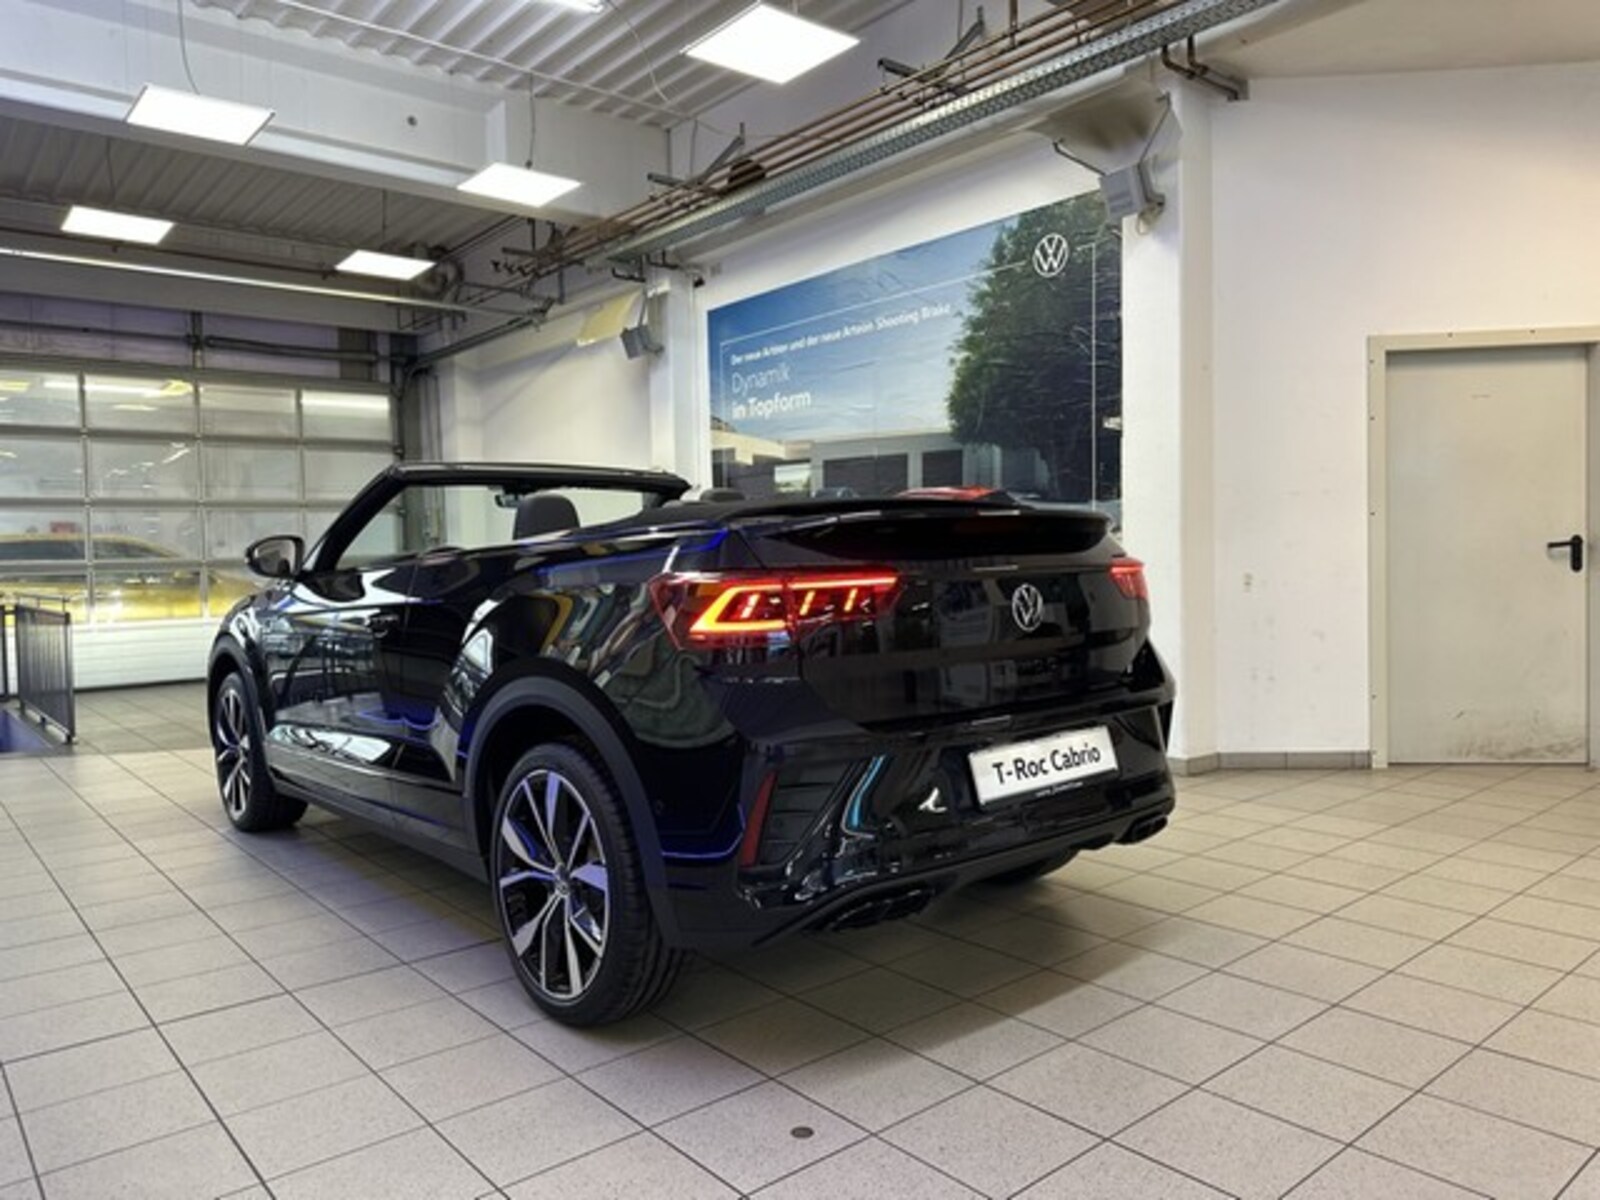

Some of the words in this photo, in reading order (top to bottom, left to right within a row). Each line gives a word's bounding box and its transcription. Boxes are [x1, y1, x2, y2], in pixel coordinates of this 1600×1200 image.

[876, 309, 919, 332] Shooting
[732, 362, 791, 397] Dynamik
[732, 401, 746, 419] in
[748, 391, 811, 419] Topform
[992, 757, 1049, 785] T-Roc
[1050, 743, 1101, 772] Cabrio
